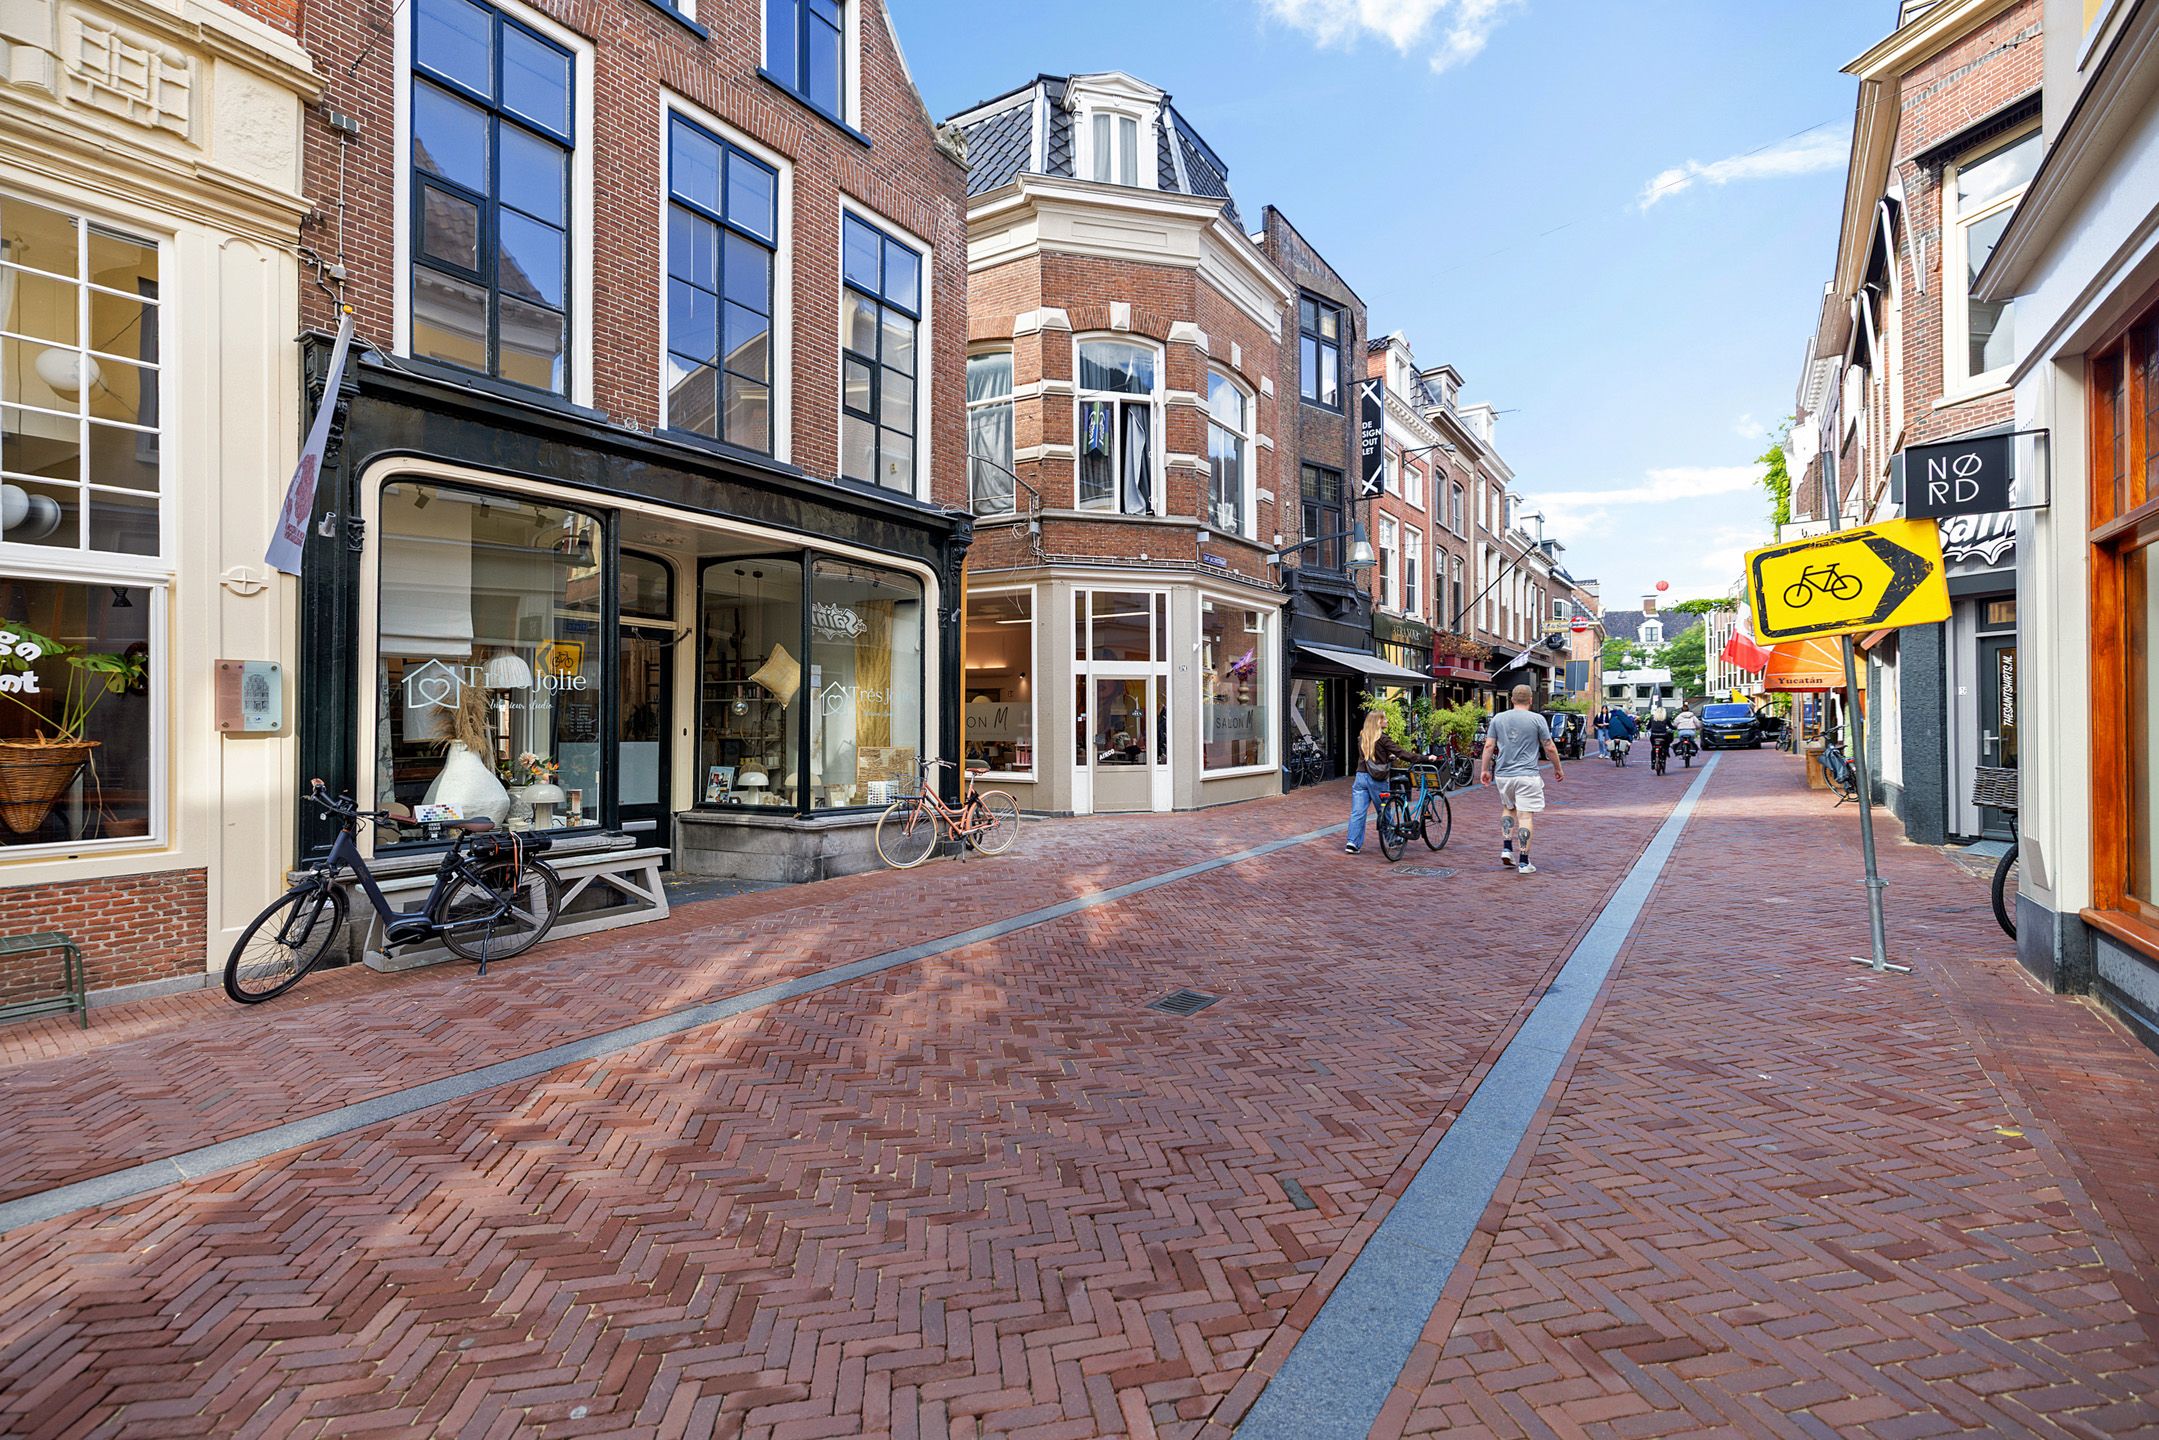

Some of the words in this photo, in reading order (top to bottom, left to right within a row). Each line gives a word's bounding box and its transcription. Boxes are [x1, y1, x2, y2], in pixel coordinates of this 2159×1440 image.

[1362, 421, 1373, 430] DE
[1362, 428, 1382, 438] SIGN
[1362, 438, 1378, 447] OUT
[1362, 447, 1374, 456] LET
[1928, 478, 1979, 506] RD
[532, 668, 587, 693] Jolie
[1215, 717, 1243, 729] SALON
